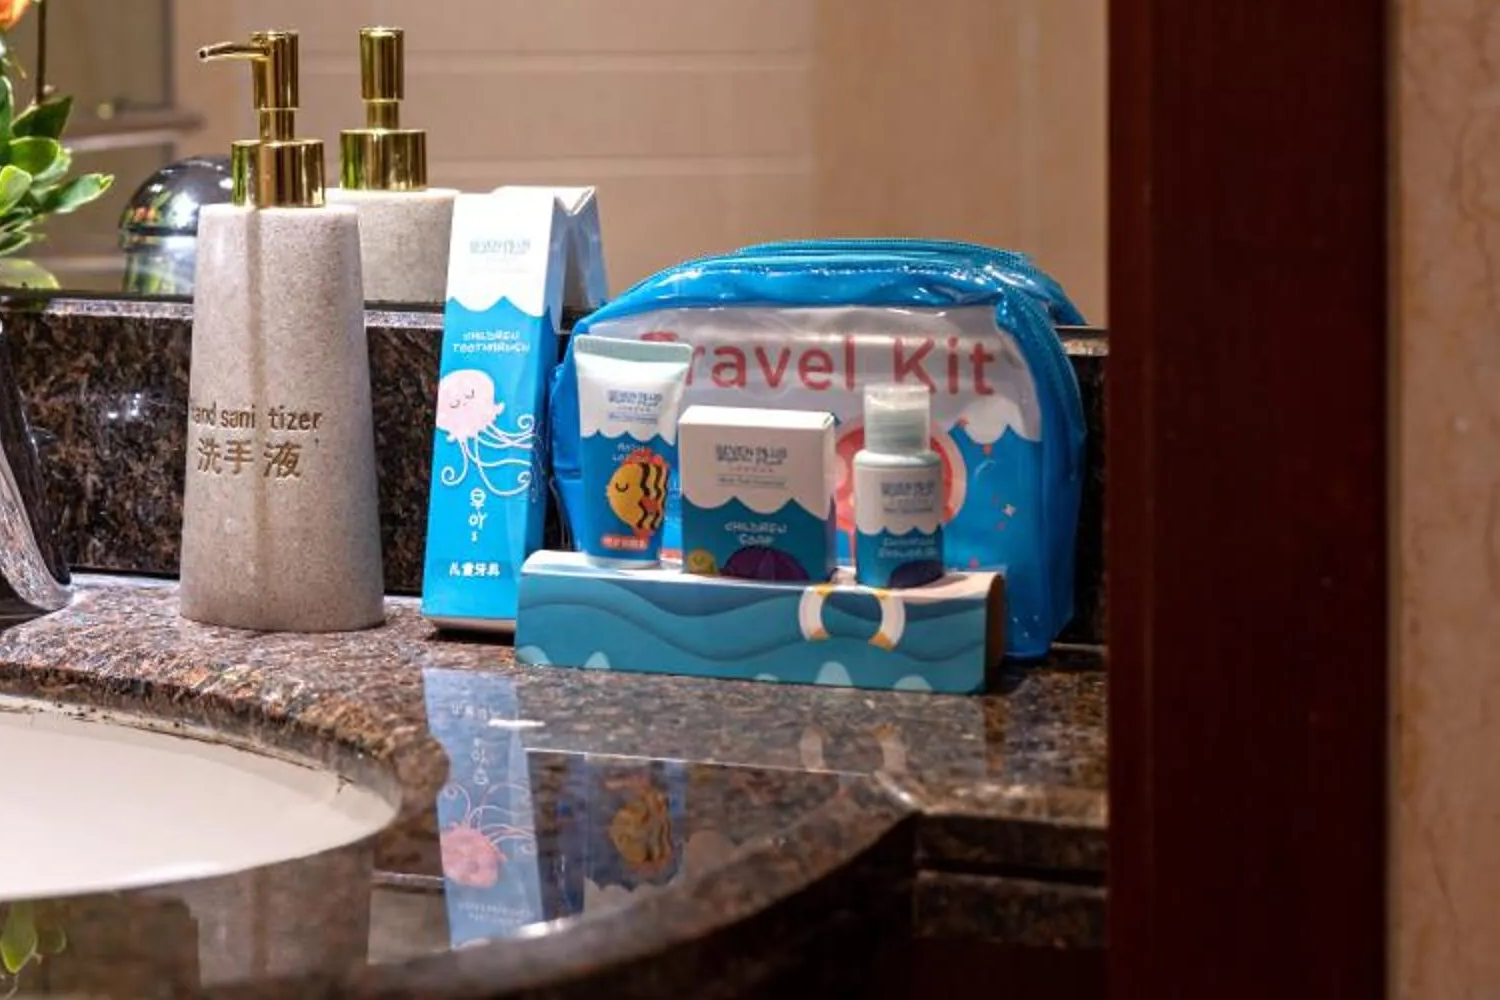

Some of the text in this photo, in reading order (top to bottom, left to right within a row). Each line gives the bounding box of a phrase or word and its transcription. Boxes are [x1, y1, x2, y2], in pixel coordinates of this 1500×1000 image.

[640, 331, 996, 397] ravel Kit
[197, 438, 302, 478] 洗手液
